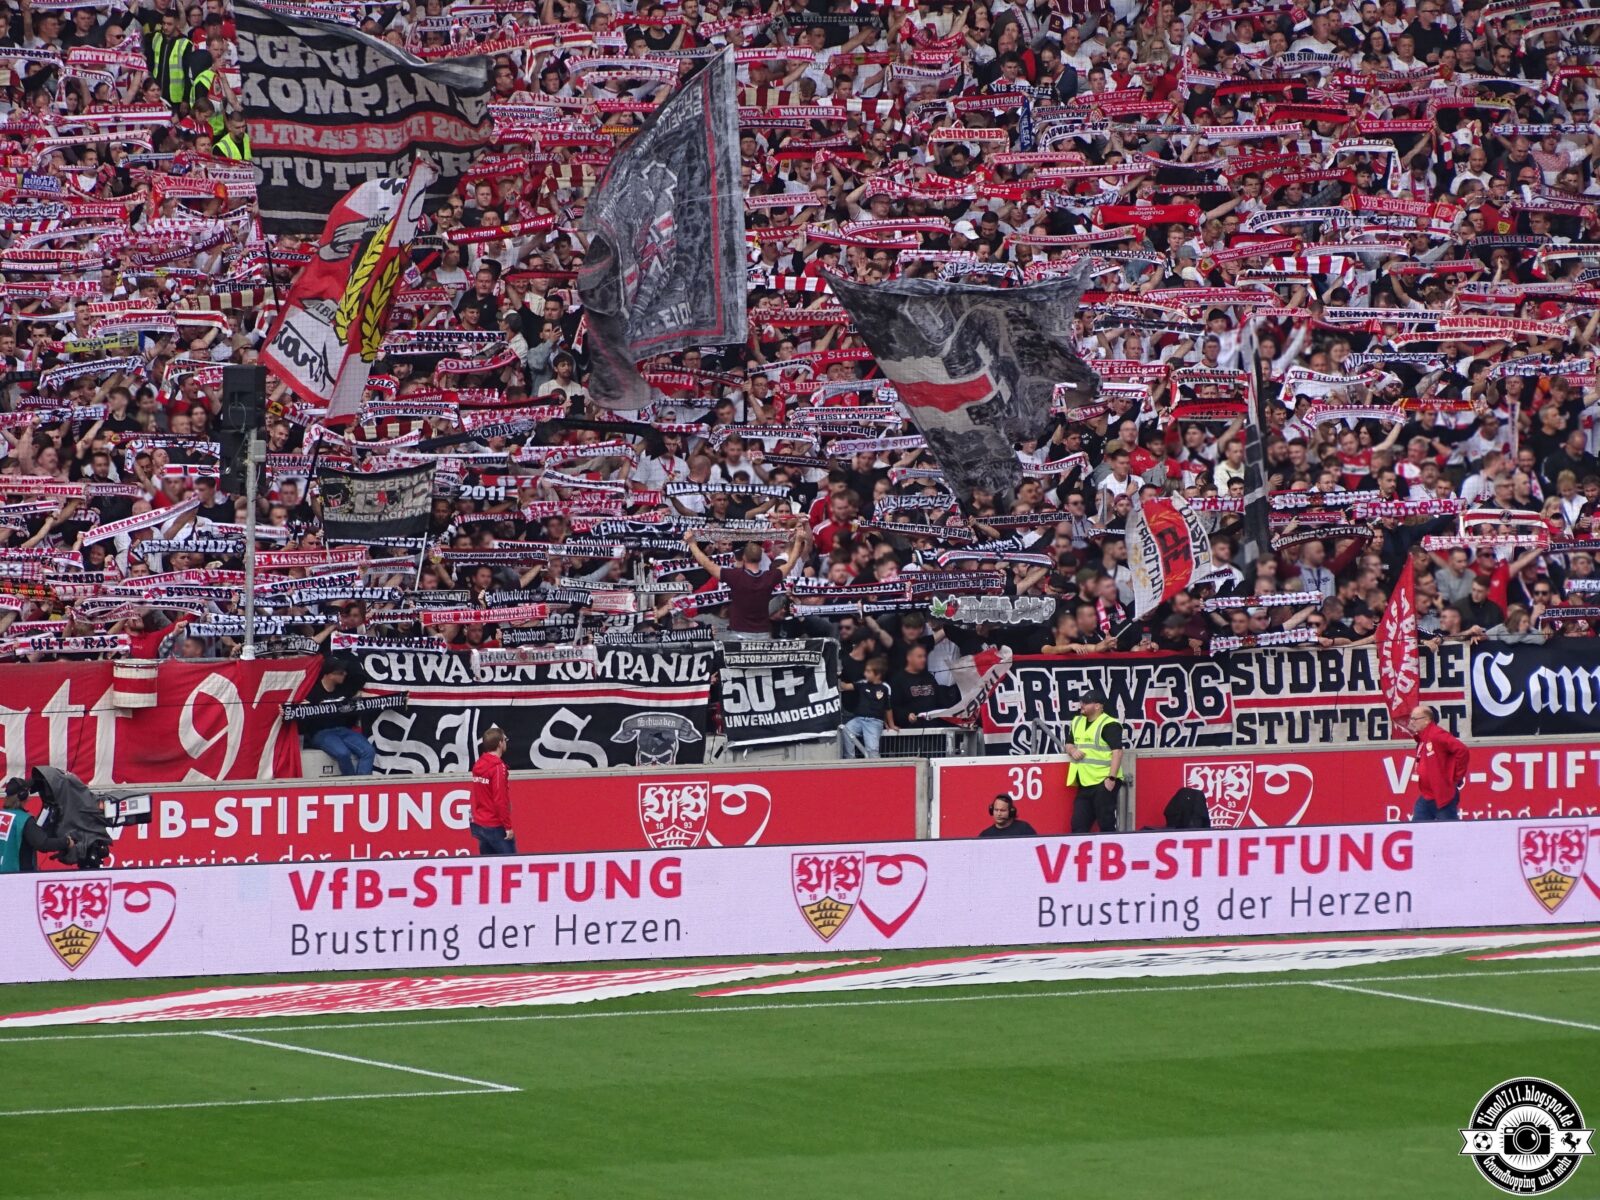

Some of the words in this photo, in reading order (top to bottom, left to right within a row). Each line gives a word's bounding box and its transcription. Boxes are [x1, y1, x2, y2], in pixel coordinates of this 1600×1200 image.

[236, 33, 395, 79] SCHWA
[562, 134, 612, 144] Stuttga
[827, 351, 870, 361] Stuttg
[814, 413, 843, 421] HEISST
[576, 445, 632, 458] Cannsta
[44, 486, 82, 496] KURVE
[460, 485, 506, 500] 2011
[666, 484, 699, 496] ALLES
[140, 540, 237, 554] ESSELSTADT
[484, 588, 530, 606] Schwaben
[501, 629, 546, 643] Schwaben
[1229, 645, 1465, 697] SÜDBADE
[722, 656, 839, 714] 50+1
[986, 664, 1155, 727] CREW
[1149, 660, 1227, 722] 36
[725, 700, 840, 729] UNVERHANDELBAR
[1007, 767, 1043, 800] 36
[107, 788, 473, 839] B-STIFTUNG
[655, 822, 665, 830] 18
[682, 819, 693, 828] 93
[1035, 830, 1414, 884] VfB-STIFTUNG
[1534, 866, 1544, 874] 18
[1562, 865, 1572, 873] 93
[288, 856, 683, 912] VfB-STIFTUNG
[808, 893, 818, 902] 18
[837, 892, 847, 901] 93
[1038, 892, 1200, 932] Brustring
[1217, 887, 1272, 921] der
[1291, 886, 1413, 917] Herzen
[53, 920, 64, 929] 18
[83, 919, 94, 928] 93
[291, 920, 460, 962] Brustring
[478, 915, 536, 950] der
[554, 913, 681, 946] Herzen
